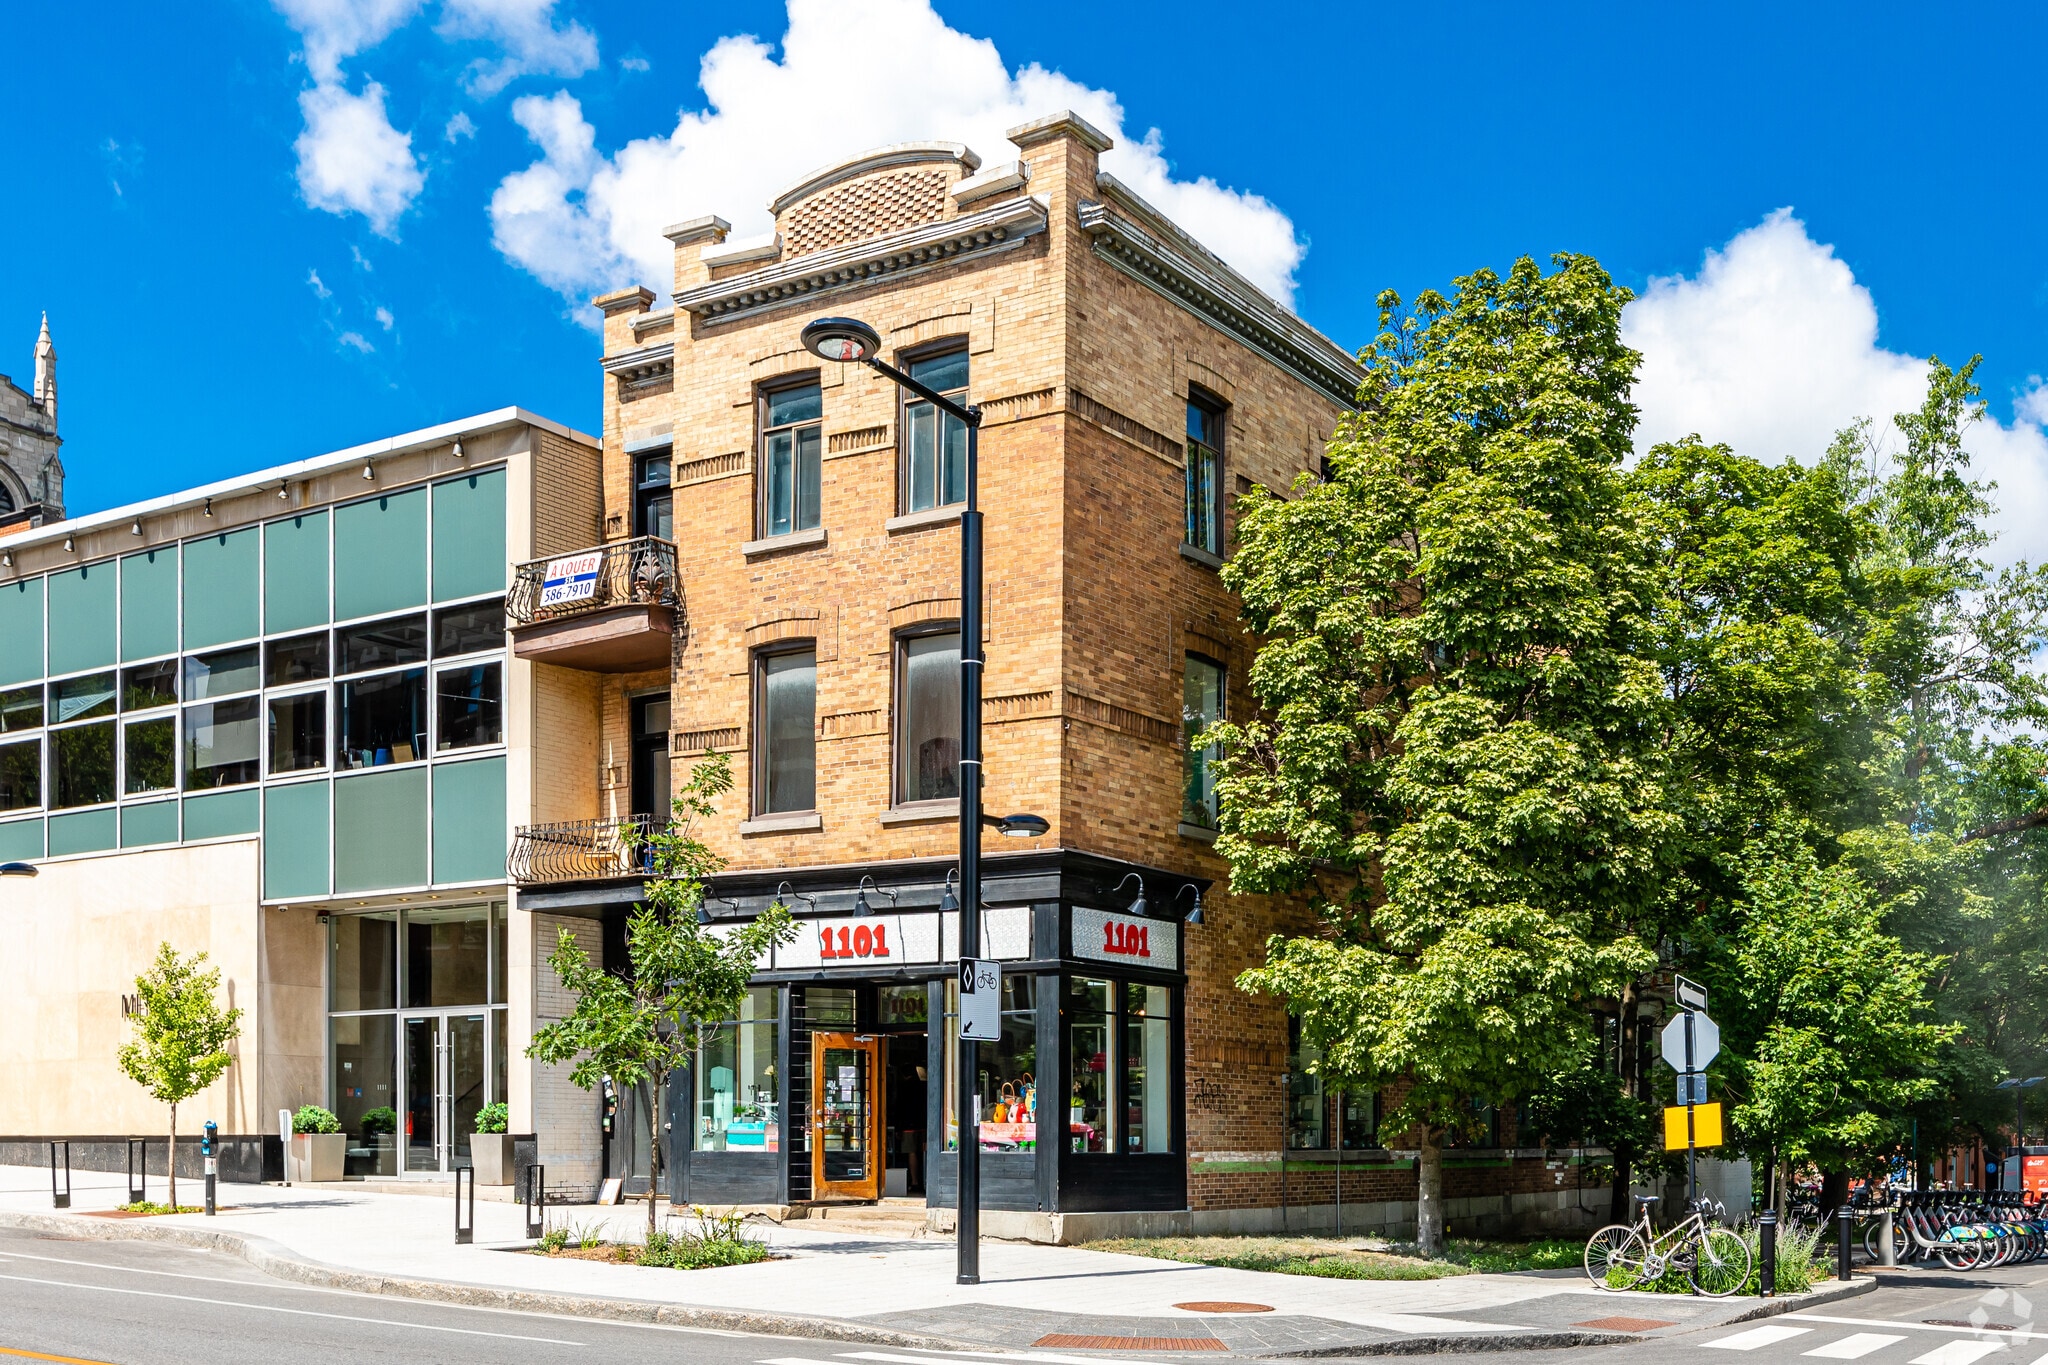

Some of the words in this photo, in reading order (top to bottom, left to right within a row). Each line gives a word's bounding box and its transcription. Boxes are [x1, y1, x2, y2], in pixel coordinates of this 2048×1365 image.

[559, 557, 596, 577] LOUER
[544, 582, 591, 603] 586-7910
[820, 924, 890, 959] 1101
[1104, 920, 1150, 957] 1101
